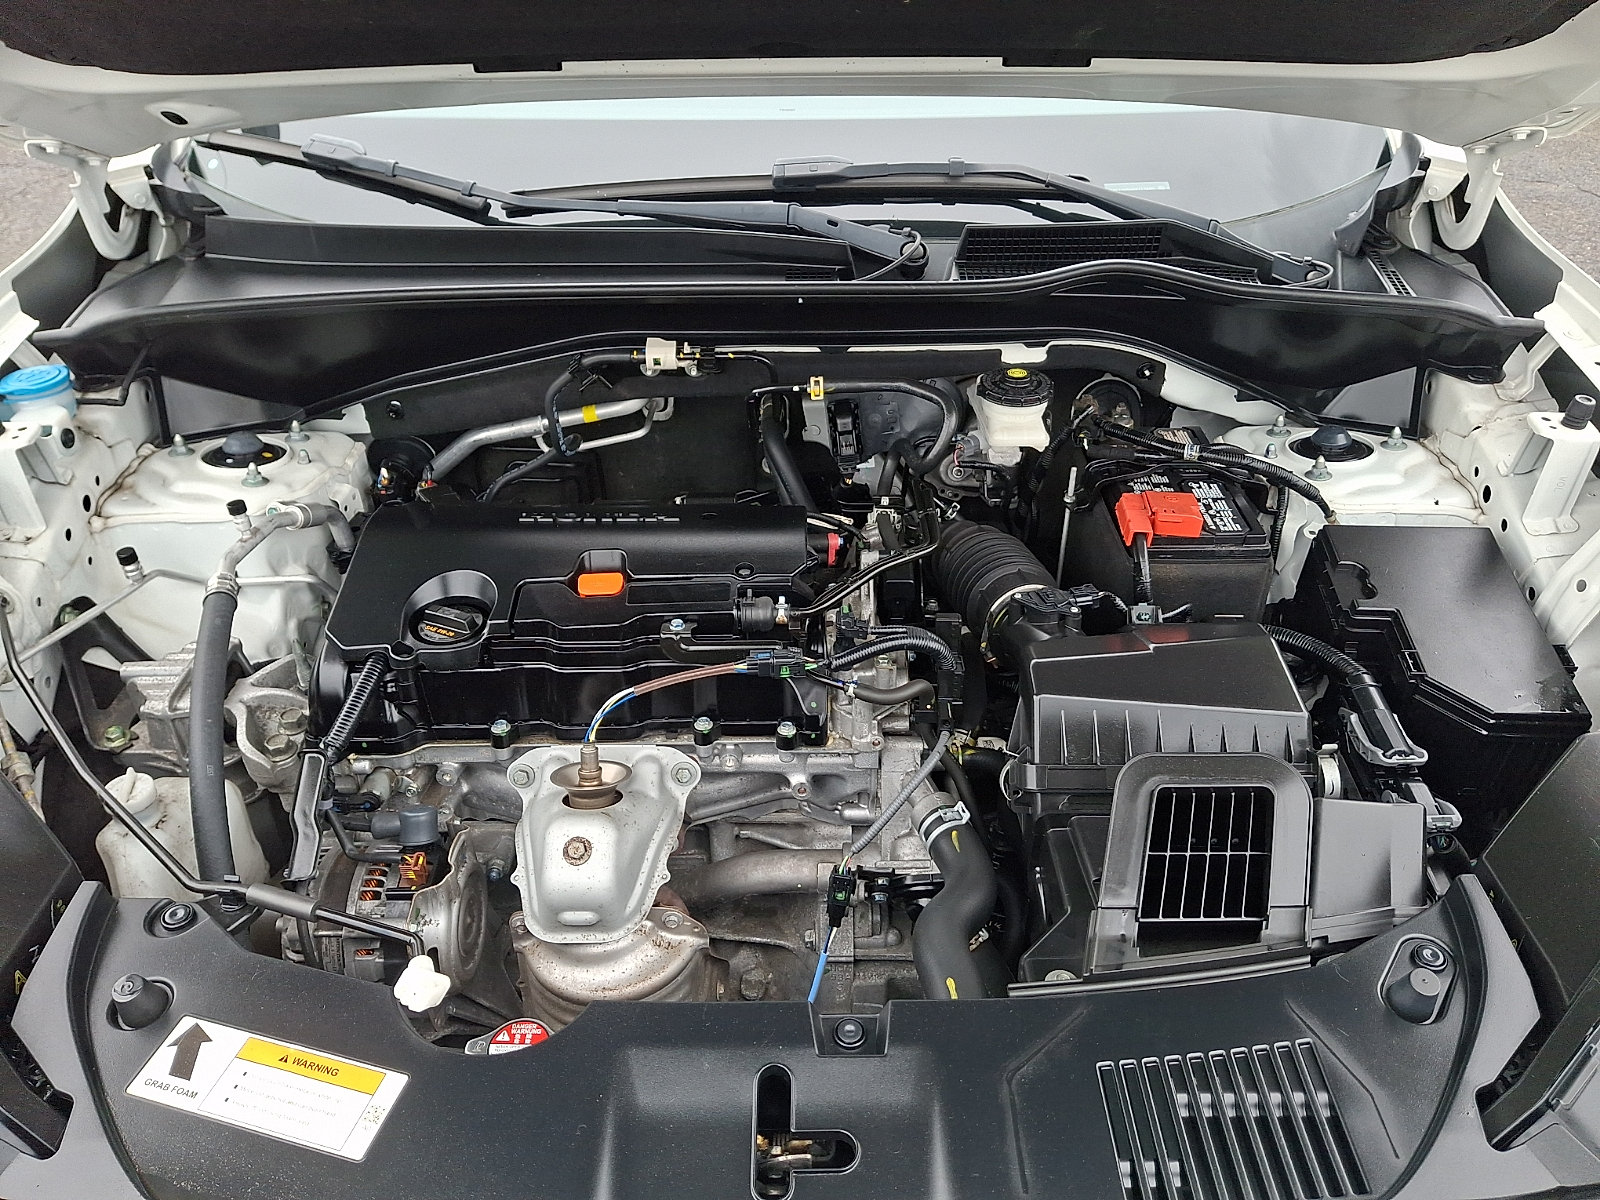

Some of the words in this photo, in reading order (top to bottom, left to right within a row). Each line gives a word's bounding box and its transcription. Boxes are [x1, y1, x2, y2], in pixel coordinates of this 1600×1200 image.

[292, 1056, 340, 1077] WARNING
[144, 1078, 170, 1093] GRAB
[171, 1085, 199, 1100] FOAM
